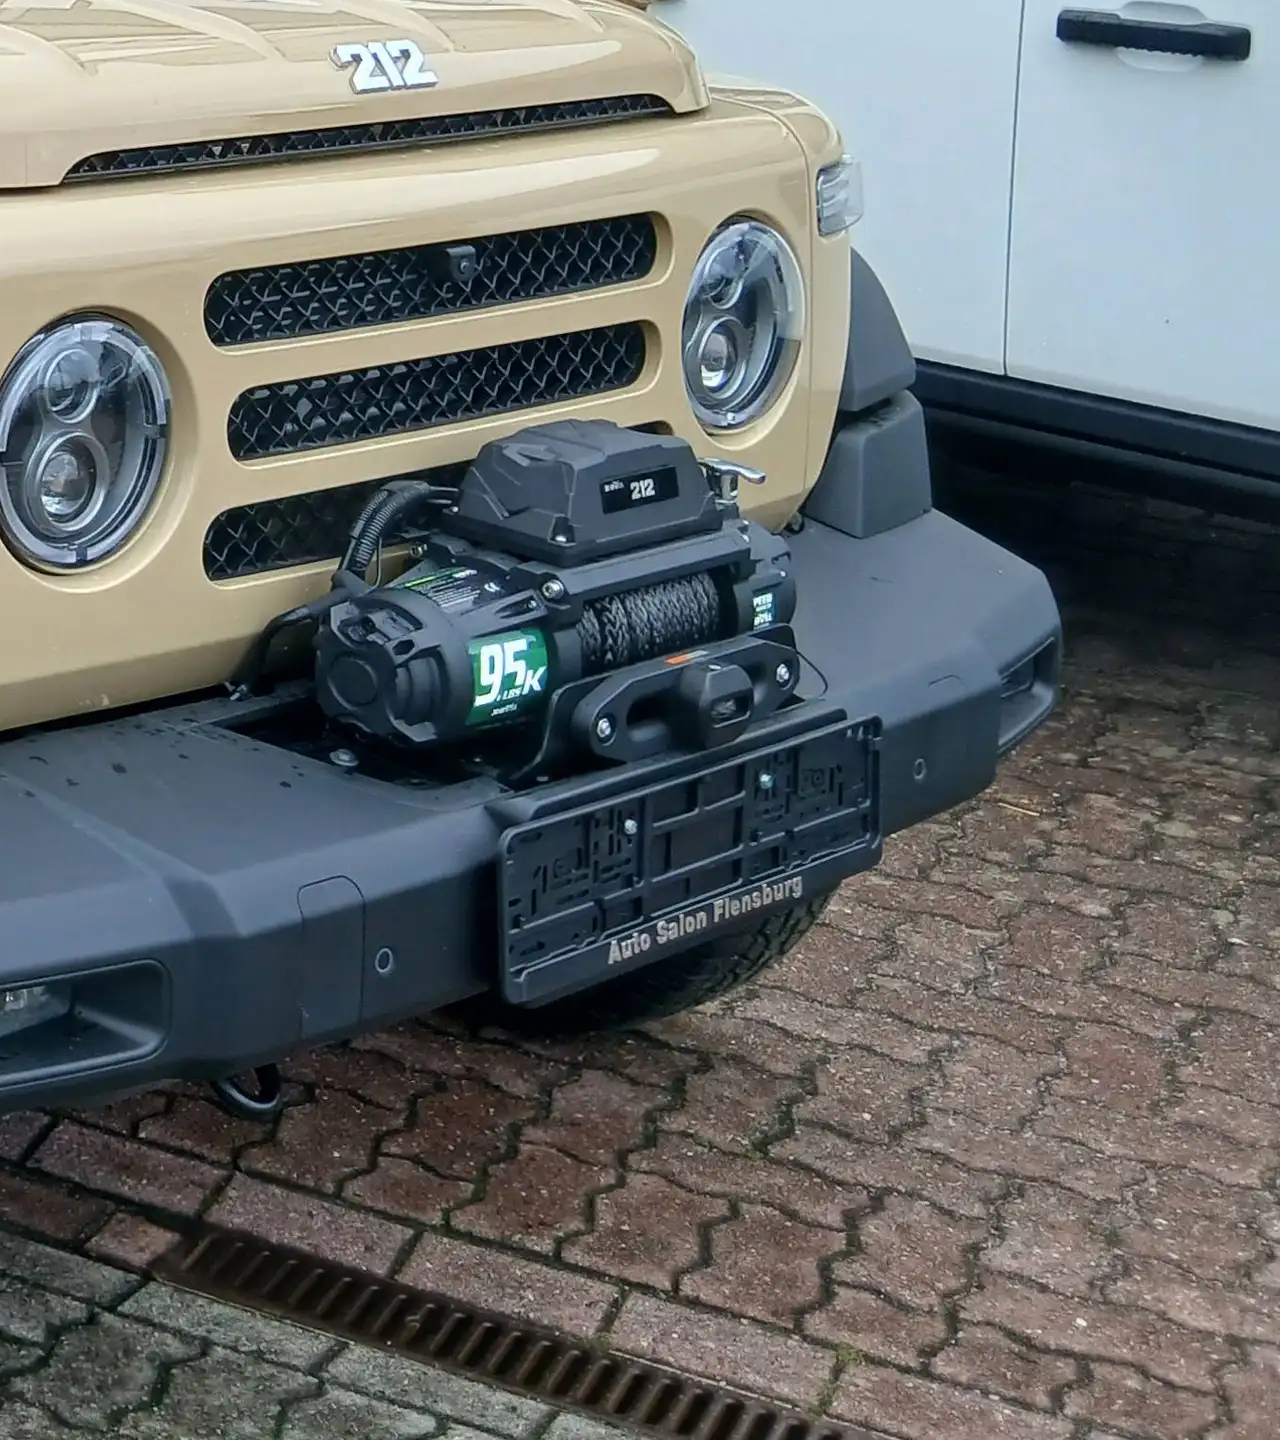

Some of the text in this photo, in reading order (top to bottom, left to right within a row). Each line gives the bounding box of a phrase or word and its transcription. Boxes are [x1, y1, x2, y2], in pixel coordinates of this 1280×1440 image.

[328, 39, 439, 95] 212
[629, 478, 656, 501] 212
[607, 875, 804, 965] Auto Salon Flensburg
